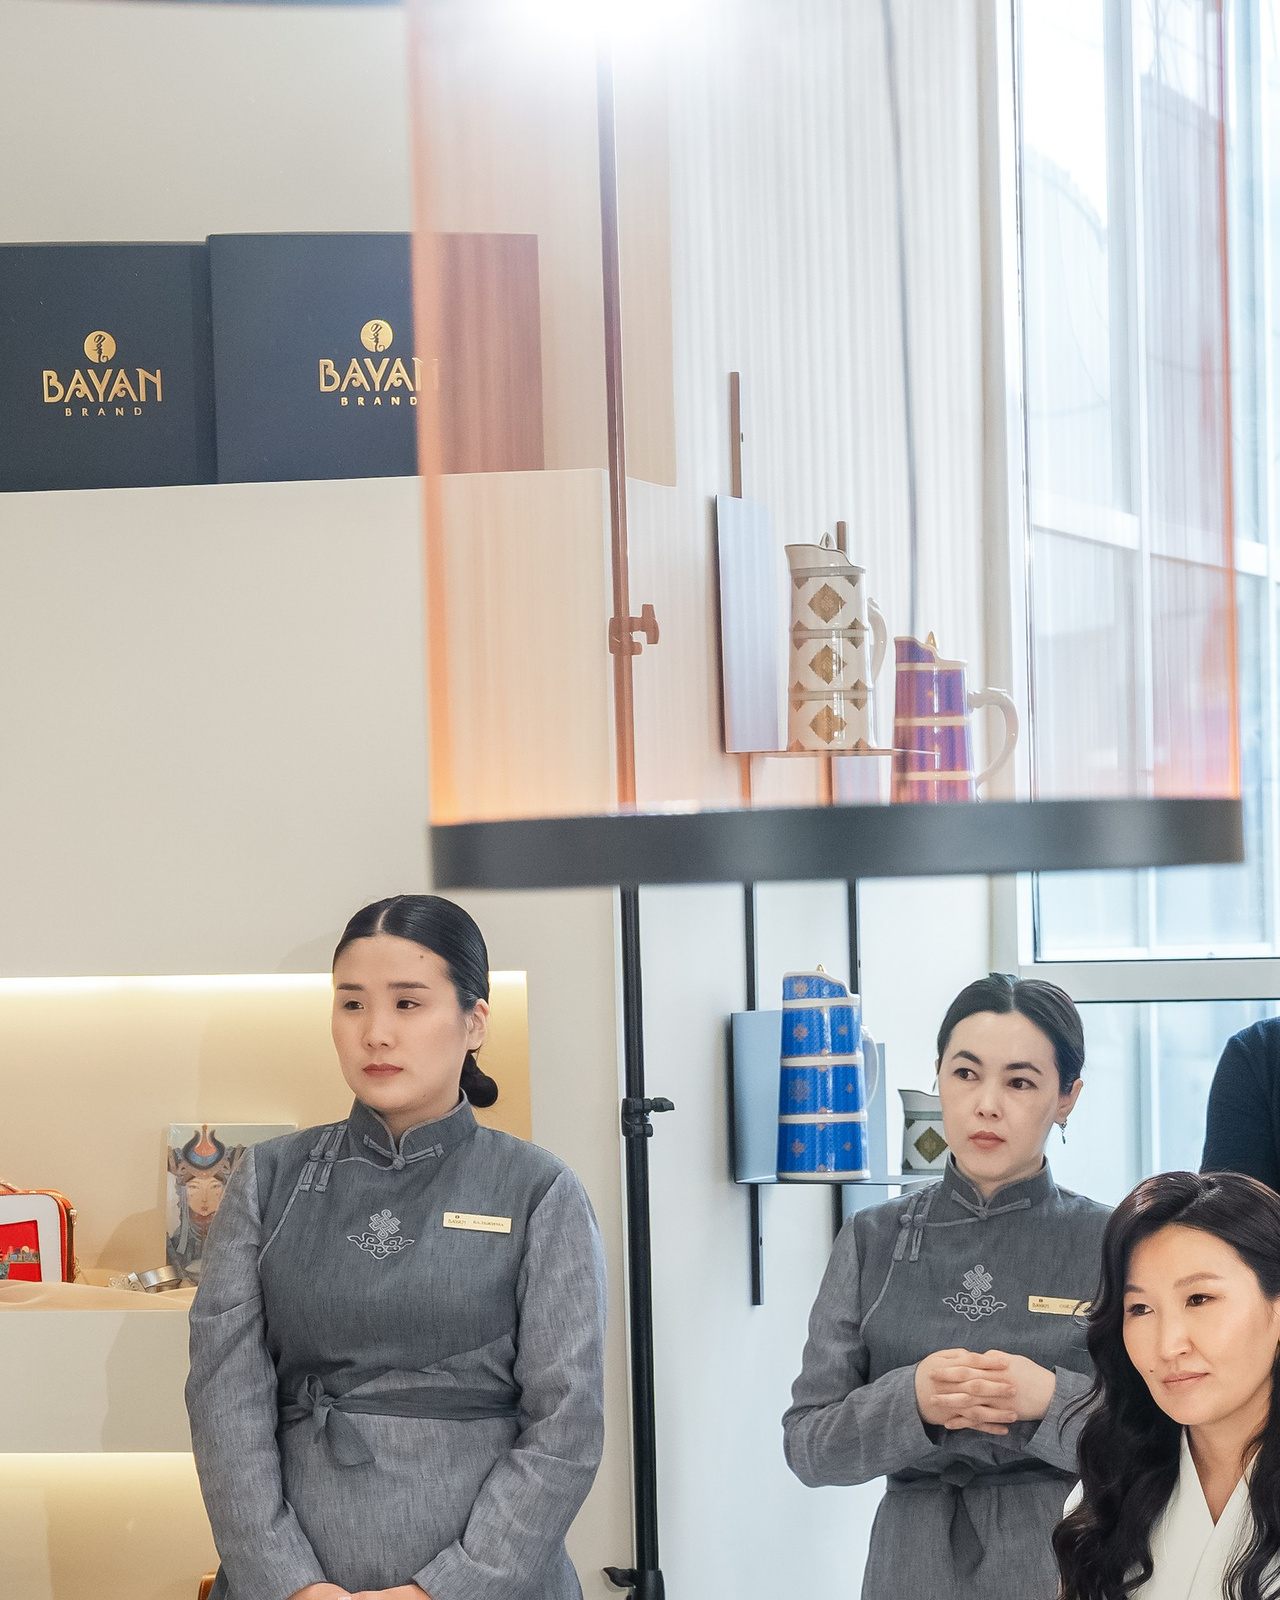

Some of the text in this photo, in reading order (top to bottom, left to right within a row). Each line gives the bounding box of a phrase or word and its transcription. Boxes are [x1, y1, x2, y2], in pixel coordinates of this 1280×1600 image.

[42, 367, 162, 402] BAYAN
[340, 396, 418, 406] BRAND
[65, 406, 142, 417] BRAND
